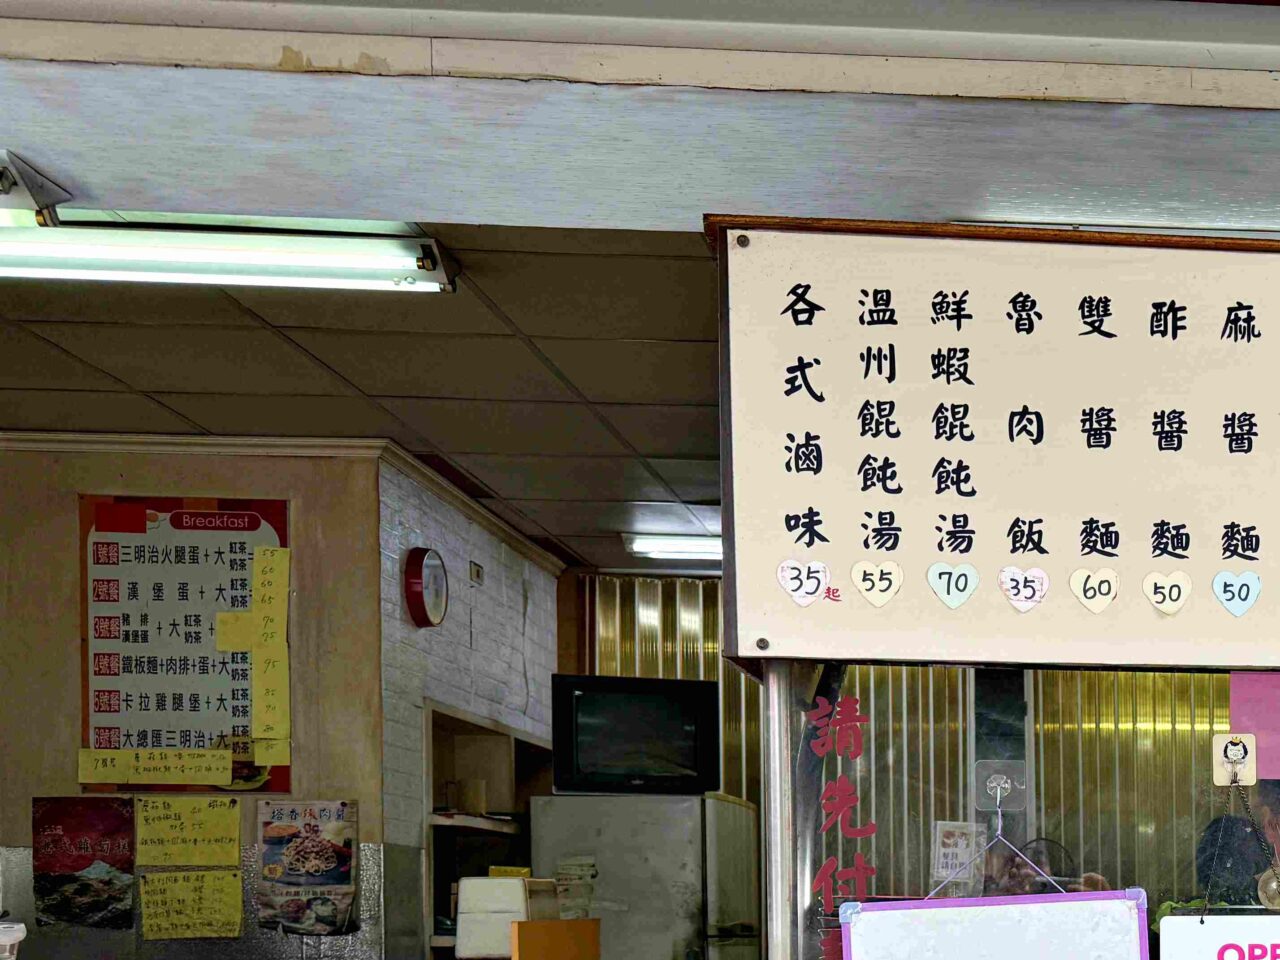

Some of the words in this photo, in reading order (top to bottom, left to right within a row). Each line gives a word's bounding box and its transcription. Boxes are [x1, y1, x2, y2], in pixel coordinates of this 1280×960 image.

[780, 282, 830, 549] 各式滷味
[857, 288, 904, 553] 溫州餛飩湯
[930, 289, 977, 554] 鮮蝦餛飩湯
[1005, 291, 1049, 556] 魯肉飯
[1077, 295, 1120, 559] 雙醬麵
[1149, 299, 1191, 560] 酢醬麵
[1220, 301, 1262, 562] 麻醬麵
[183, 514, 249, 528] Breakfast
[790, 566, 821, 593] 35
[823, 585, 842, 602] 起
[861, 569, 893, 593] 55
[938, 571, 968, 596] 70
[1010, 576, 1036, 600] 35
[1082, 574, 1112, 600] 60
[1153, 582, 1182, 604] 50
[1223, 581, 1250, 602] 50
